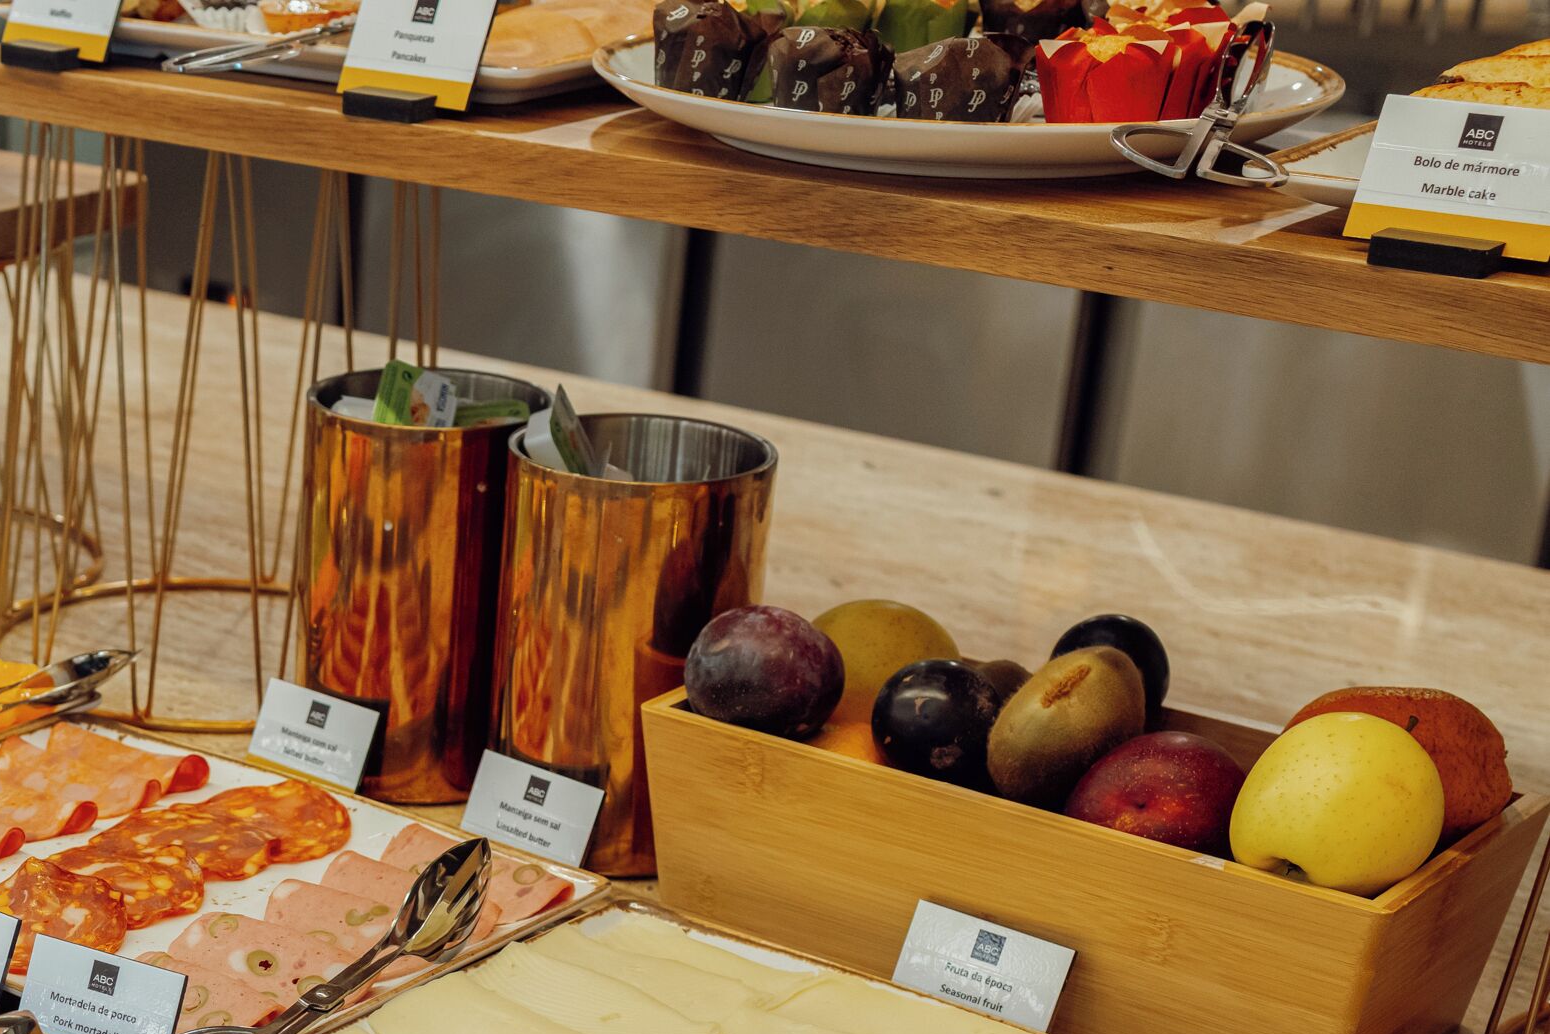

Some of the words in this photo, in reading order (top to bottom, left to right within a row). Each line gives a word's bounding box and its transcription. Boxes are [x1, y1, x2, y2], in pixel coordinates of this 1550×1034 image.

[394, 30, 435, 43] Panquecas
[391, 50, 426, 63] Pancakes
[1465, 128, 1495, 140] ABC
[1463, 139, 1492, 147] HOTELS
[1414, 155, 1441, 169] Bolo
[1444, 159, 1460, 170] de
[1462, 162, 1520, 177] mármore
[1421, 183, 1465, 198] Marble
[1468, 189, 1496, 201] cake
[281, 726, 311, 743] Manteiga
[528, 786, 546, 798] ABC
[499, 801, 532, 820] Manteiga
[533, 815, 549, 826] sem
[550, 822, 561, 831] sal
[529, 832, 551, 848] butter
[977, 943, 999, 956] ABC
[93, 974, 114, 986] ABC
[944, 962, 969, 978] Fruta
[971, 971, 982, 982] da
[985, 976, 1013, 993] época
[939, 983, 981, 1005] Seasonal
[982, 998, 1003, 1013] fruit
[50, 991, 96, 1013] Mortadela
[98, 1005, 109, 1016] de
[110, 1011, 137, 1024] porco
[53, 1015, 73, 1029] Pork
